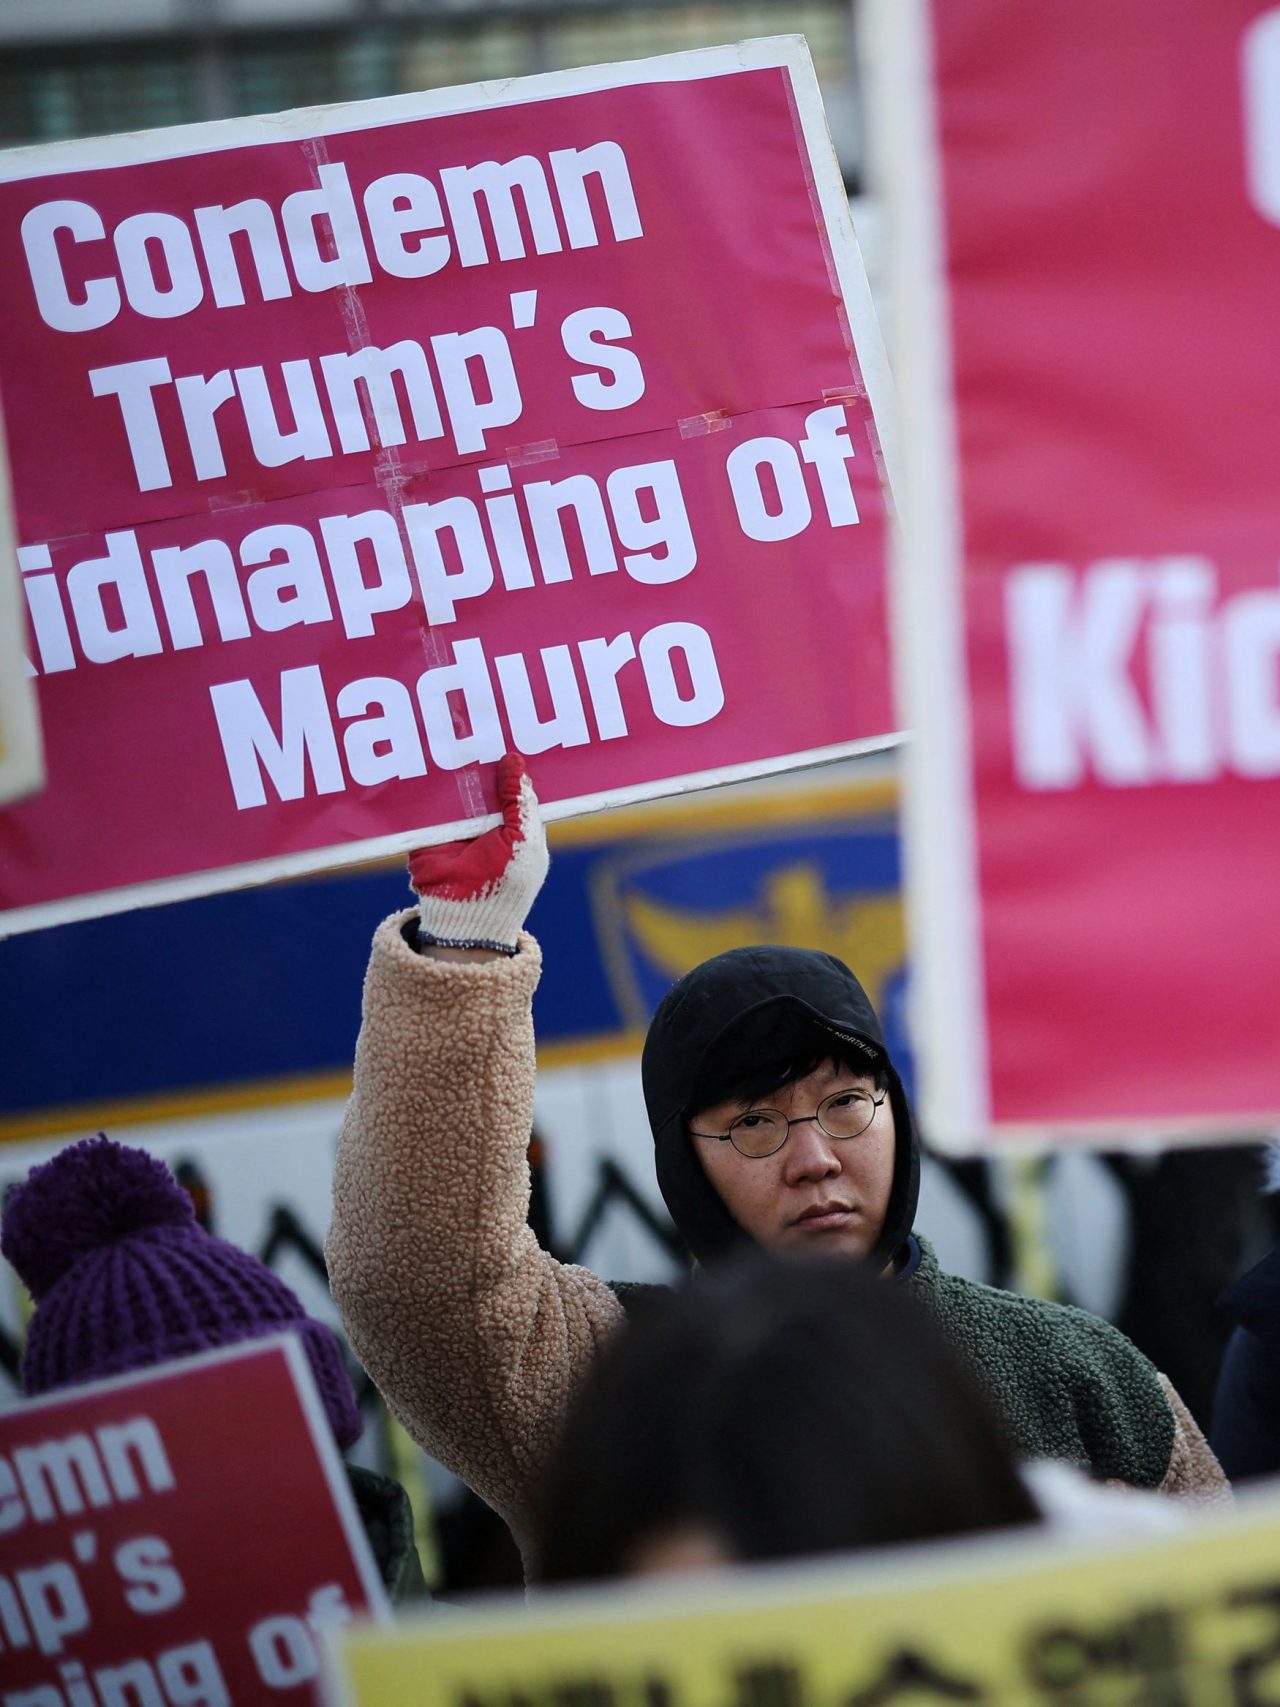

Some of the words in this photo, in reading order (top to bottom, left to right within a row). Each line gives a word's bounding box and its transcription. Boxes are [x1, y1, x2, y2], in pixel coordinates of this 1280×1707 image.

[21, 140, 644, 333] Condemn
[89, 289, 645, 492] Trump's
[16, 460, 698, 678] idnapping
[727, 405, 860, 542] of
[210, 622, 724, 811] Maduro
[834, 1031, 867, 1049] NORTH
